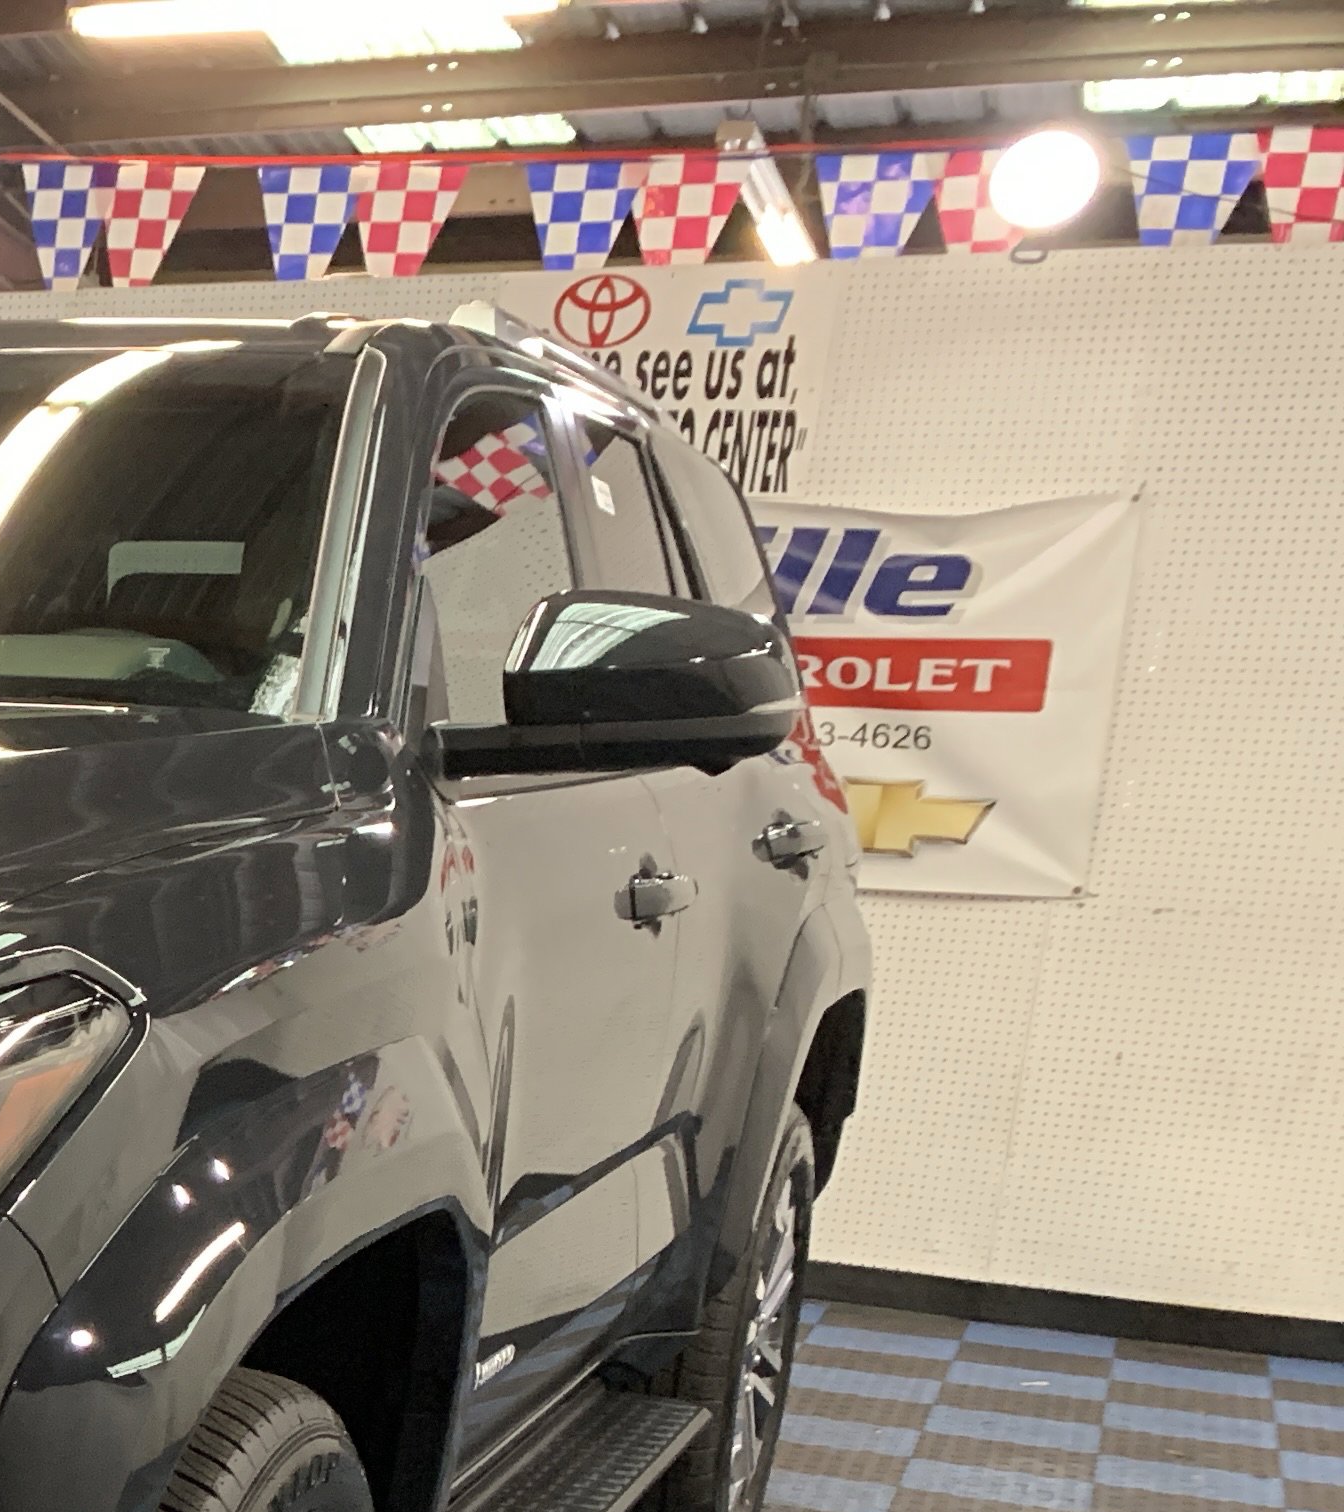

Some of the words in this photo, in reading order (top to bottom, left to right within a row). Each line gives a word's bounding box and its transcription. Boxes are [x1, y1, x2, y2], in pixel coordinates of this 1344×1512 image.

[636, 349, 693, 400] see
[704, 349, 747, 400] us
[796, 654, 1012, 693] ROLET
